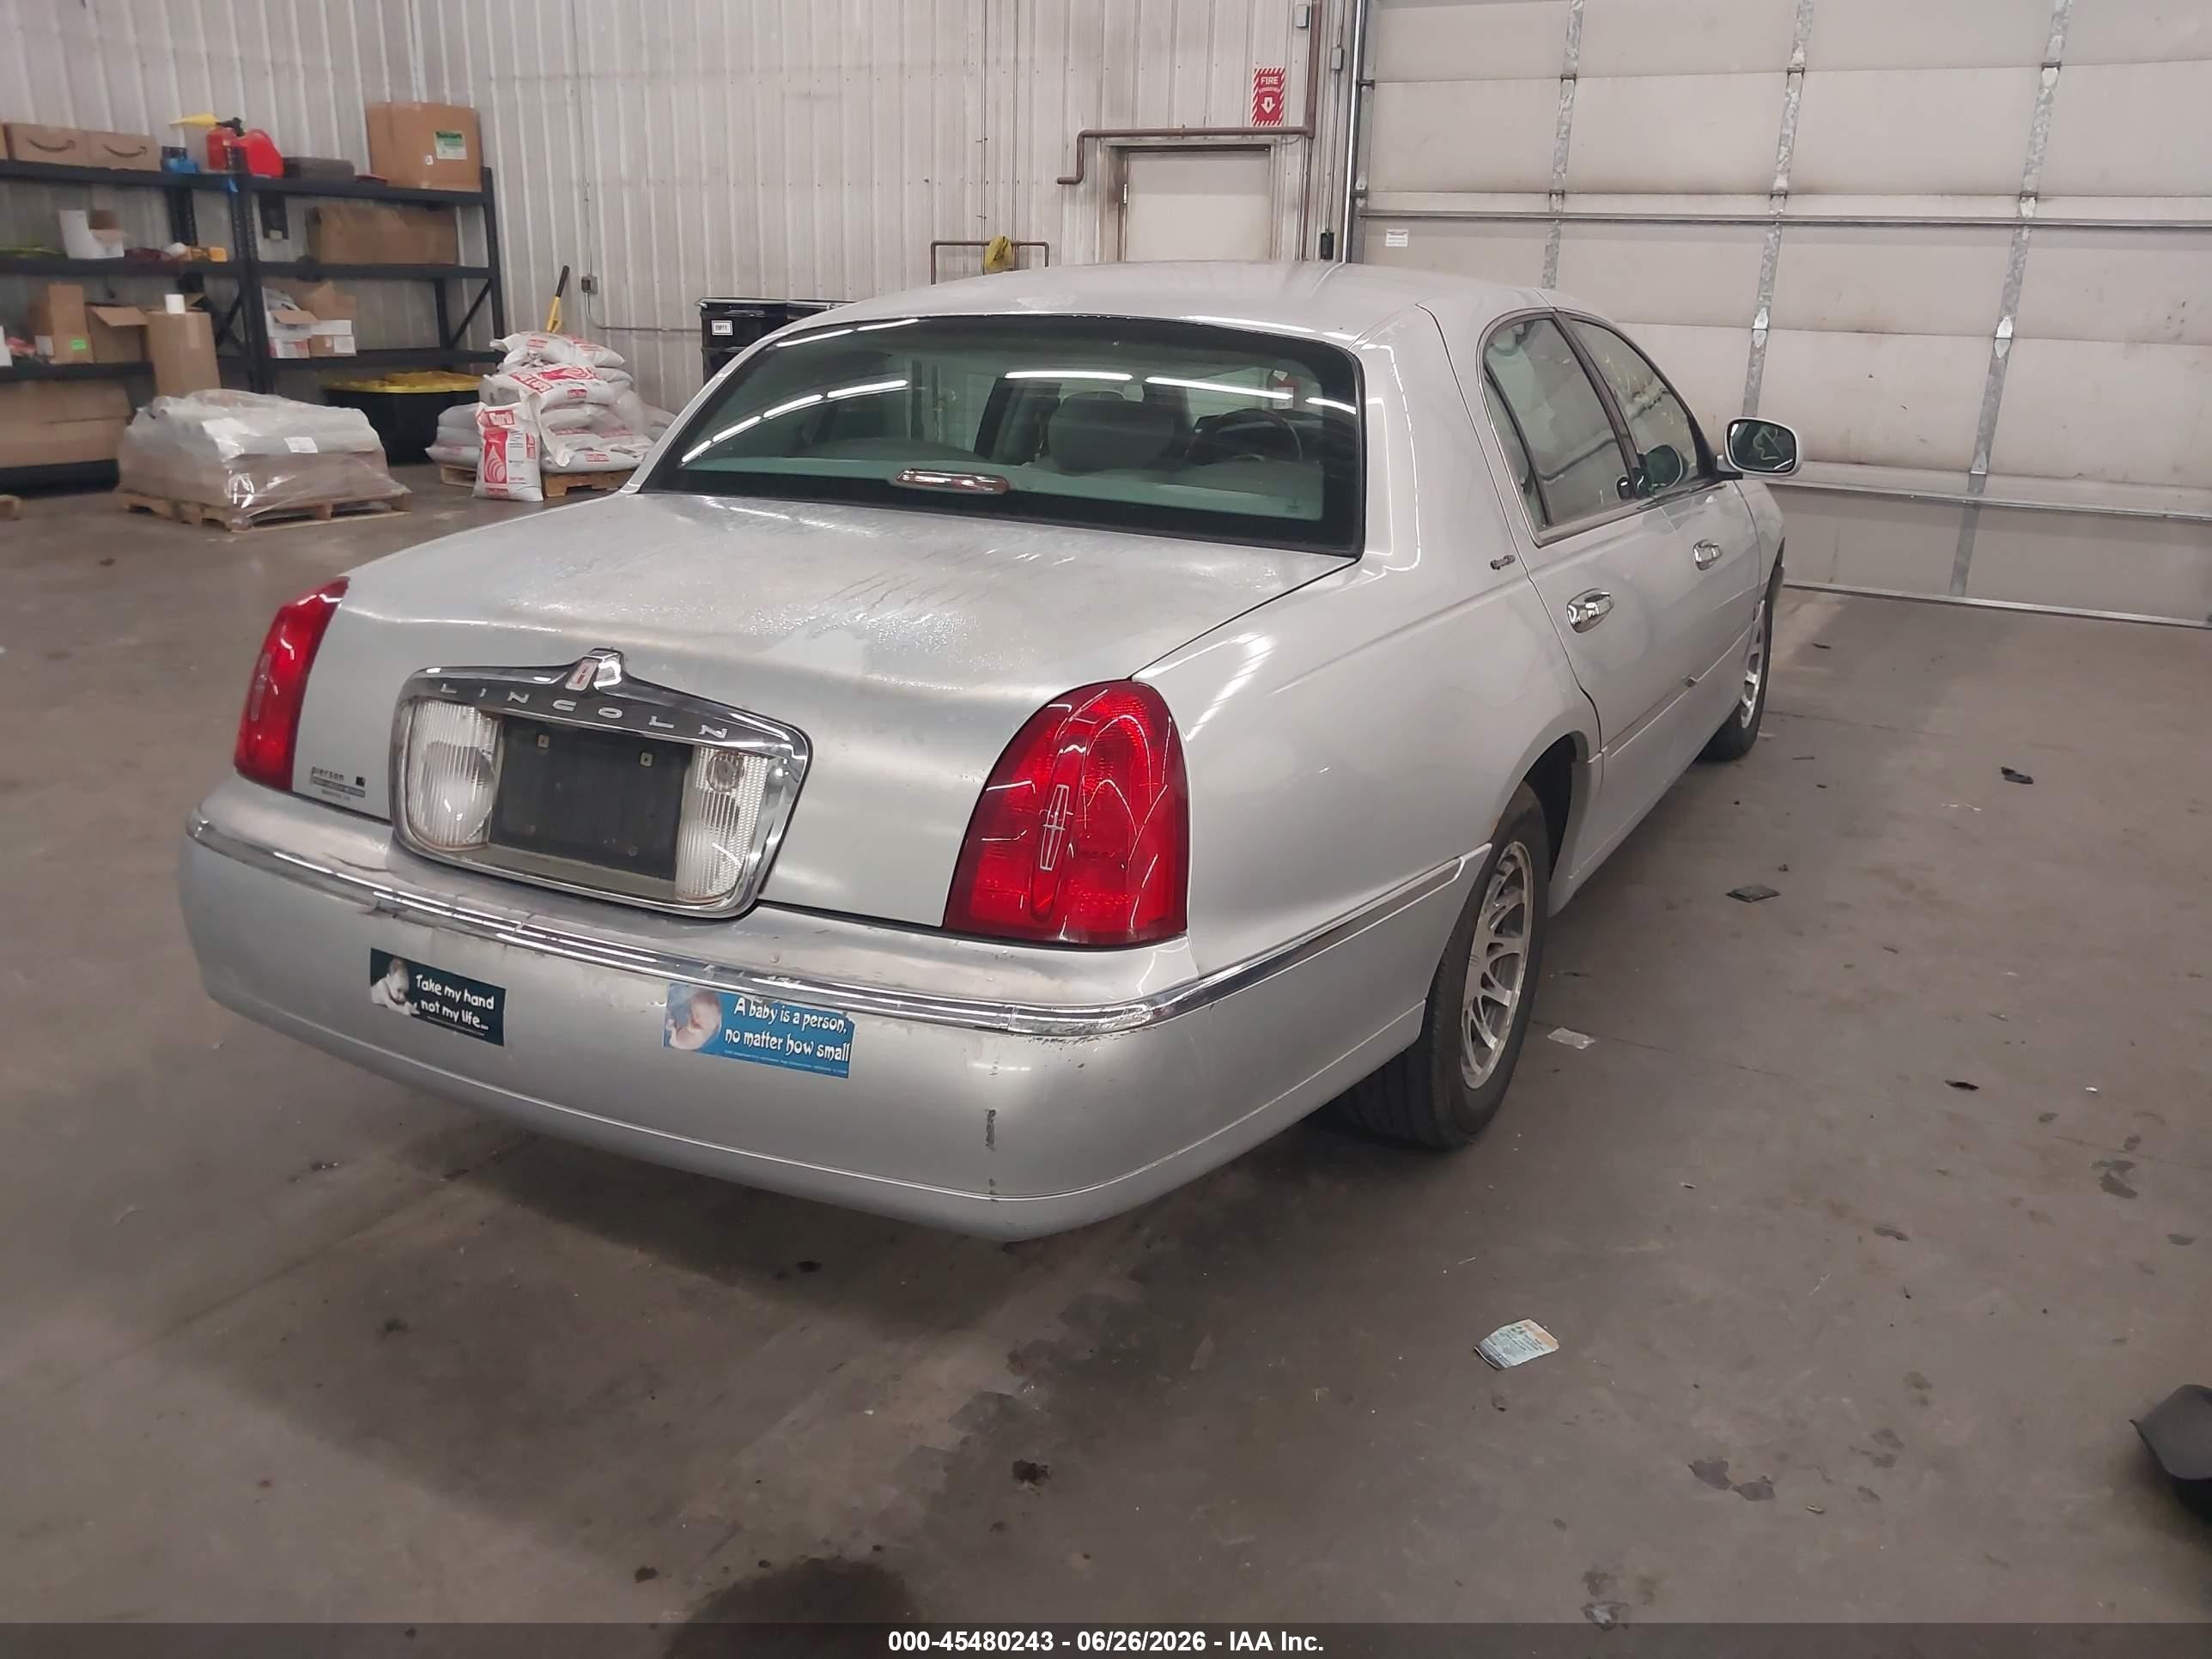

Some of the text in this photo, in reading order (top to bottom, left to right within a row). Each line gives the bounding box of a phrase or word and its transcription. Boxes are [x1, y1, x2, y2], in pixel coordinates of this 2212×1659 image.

[1260, 76, 1279, 85] FIRE
[440, 683, 728, 739] LINCOLN
[416, 975, 494, 1009] Take my hand
[420, 1000, 440, 1013] not
[442, 1006, 459, 1023] my
[733, 997, 847, 1034] A baby is a person,
[725, 1029, 741, 1044] no
[744, 1030, 783, 1051] matter
[785, 1033, 815, 1056] how
[816, 1042, 851, 1062] small
